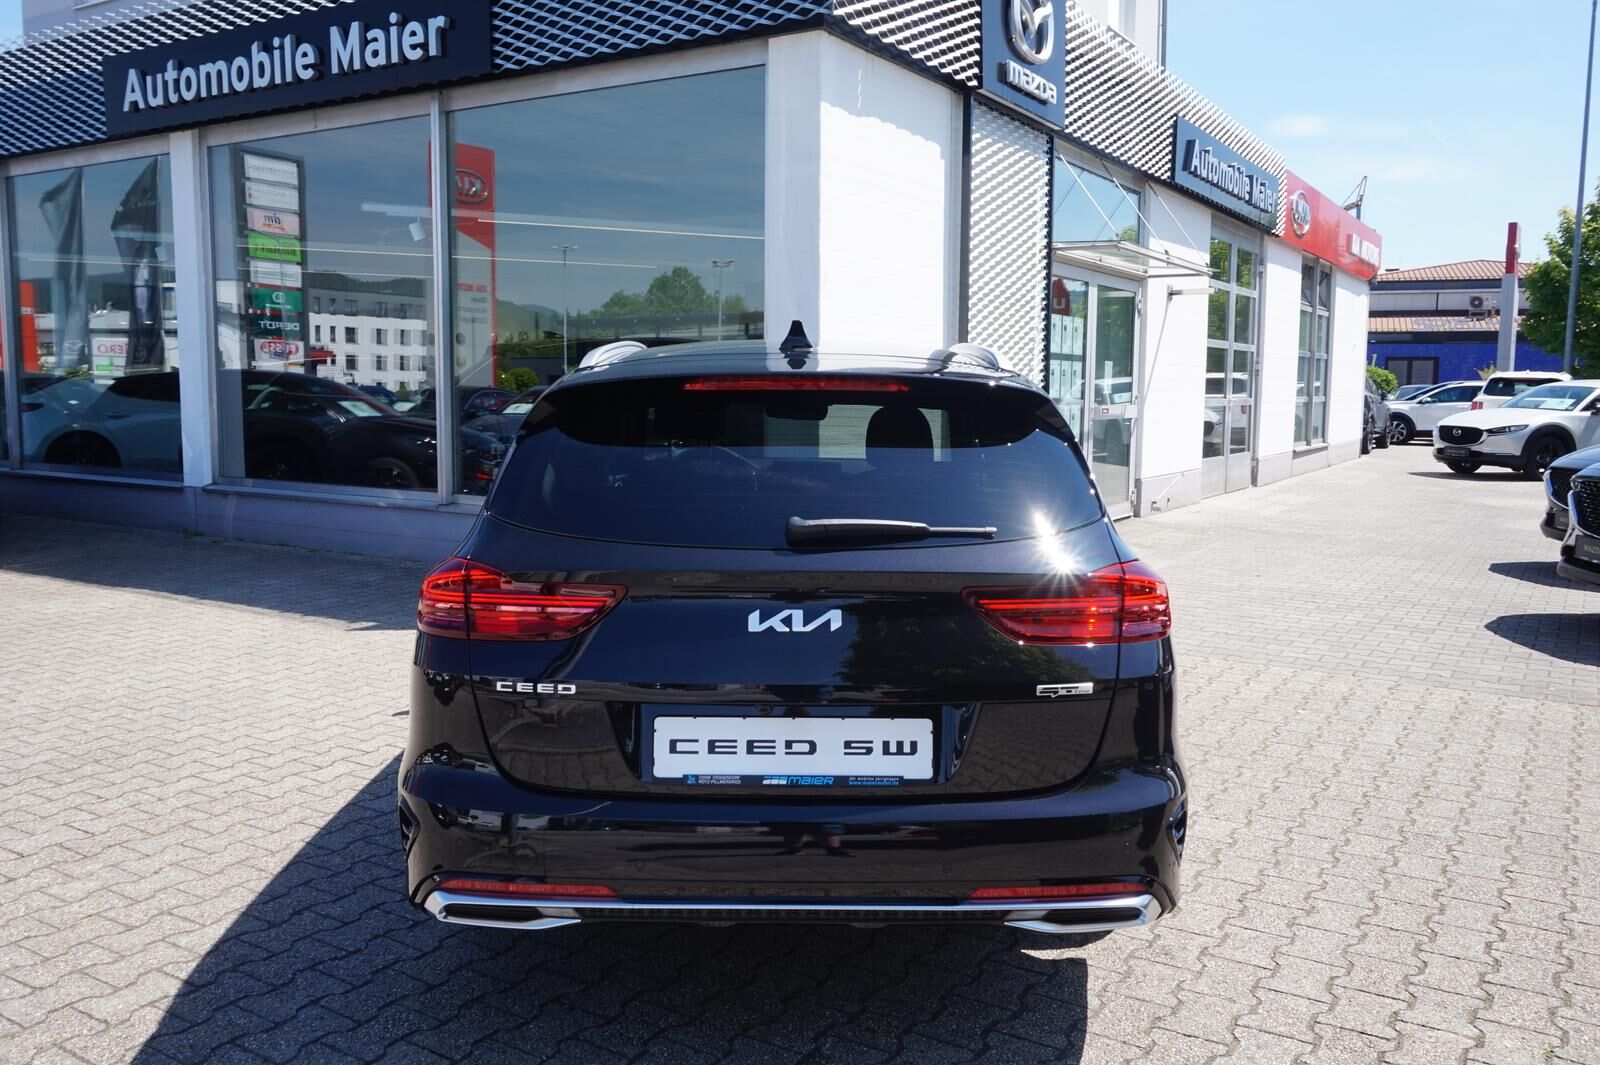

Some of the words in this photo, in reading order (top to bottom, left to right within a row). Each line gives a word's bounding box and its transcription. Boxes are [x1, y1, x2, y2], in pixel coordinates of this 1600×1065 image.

[123, 34, 319, 112] Automobile
[329, 12, 450, 75] Maier
[1189, 138, 1251, 200] Automobile
[1252, 175, 1277, 213] Maier
[747, 609, 843, 633] KIA
[495, 681, 577, 695] CEED
[668, 738, 818, 756] CEED
[843, 739, 918, 757] SW
